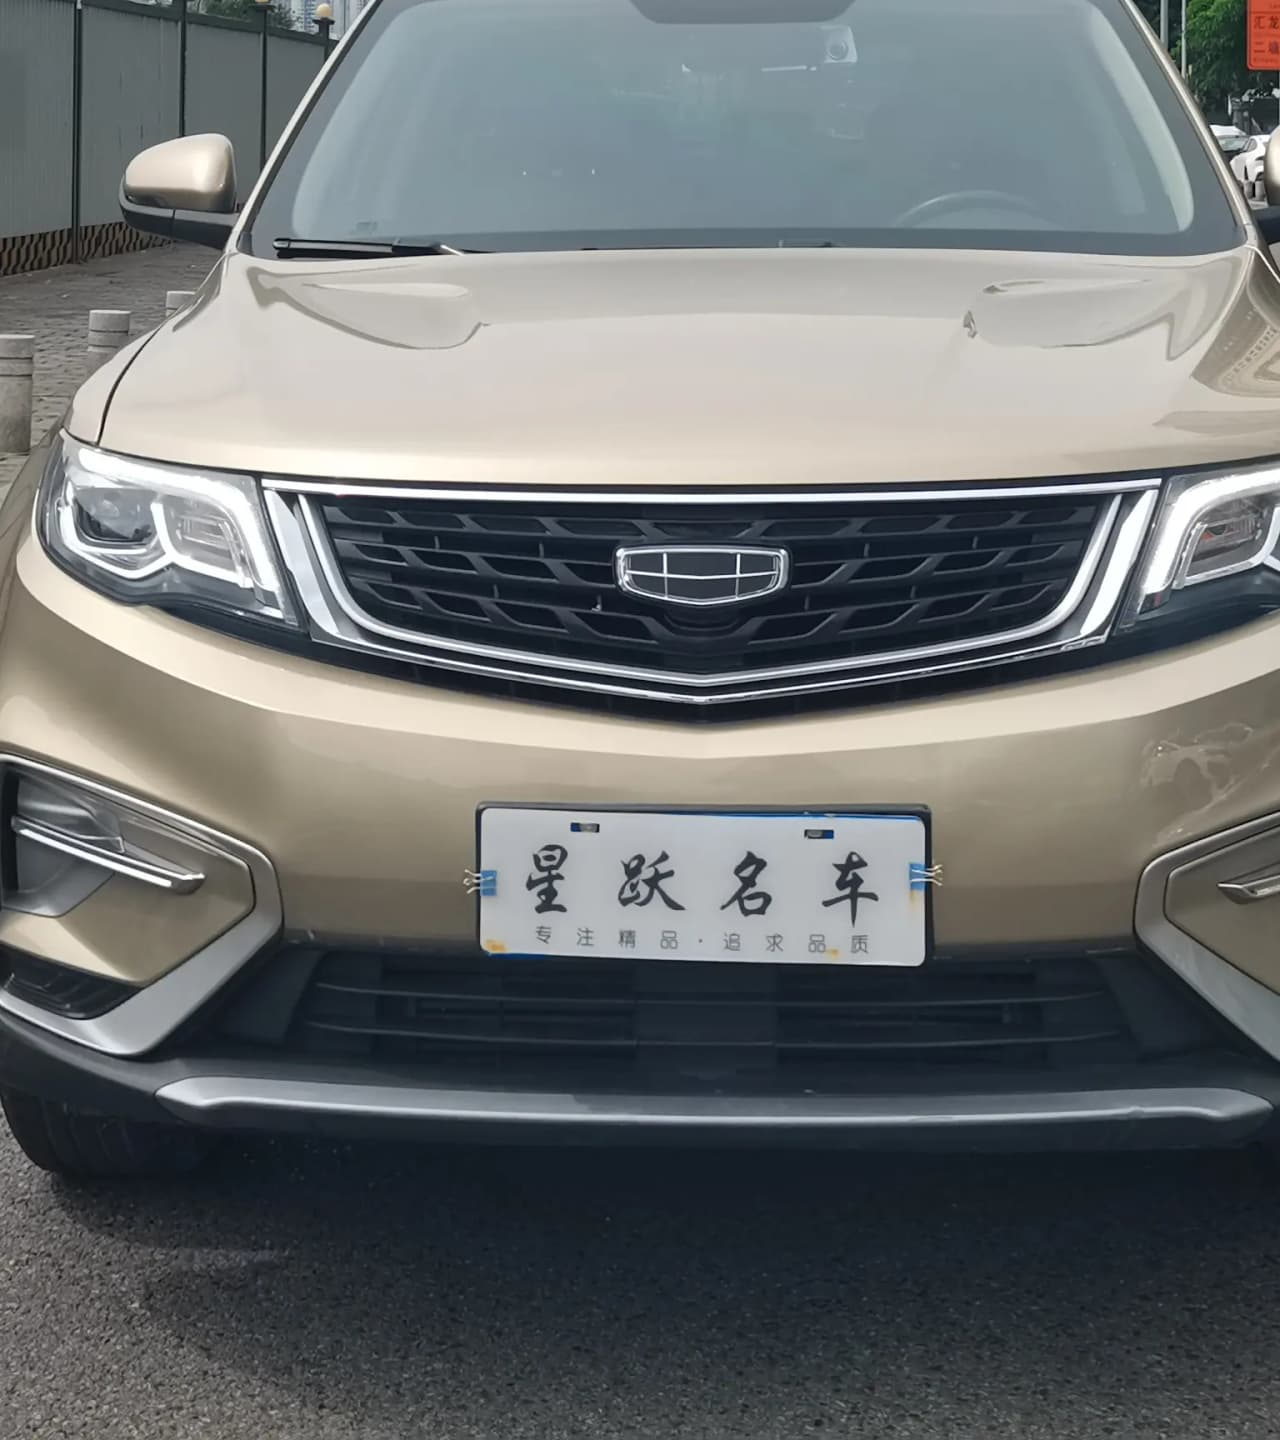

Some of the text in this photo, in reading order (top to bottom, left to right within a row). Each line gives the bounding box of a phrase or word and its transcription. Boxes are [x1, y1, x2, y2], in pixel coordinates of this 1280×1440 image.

[525, 844, 880, 928] 星跃名车
[535, 925, 870, 954] 专注精品·追求品质
